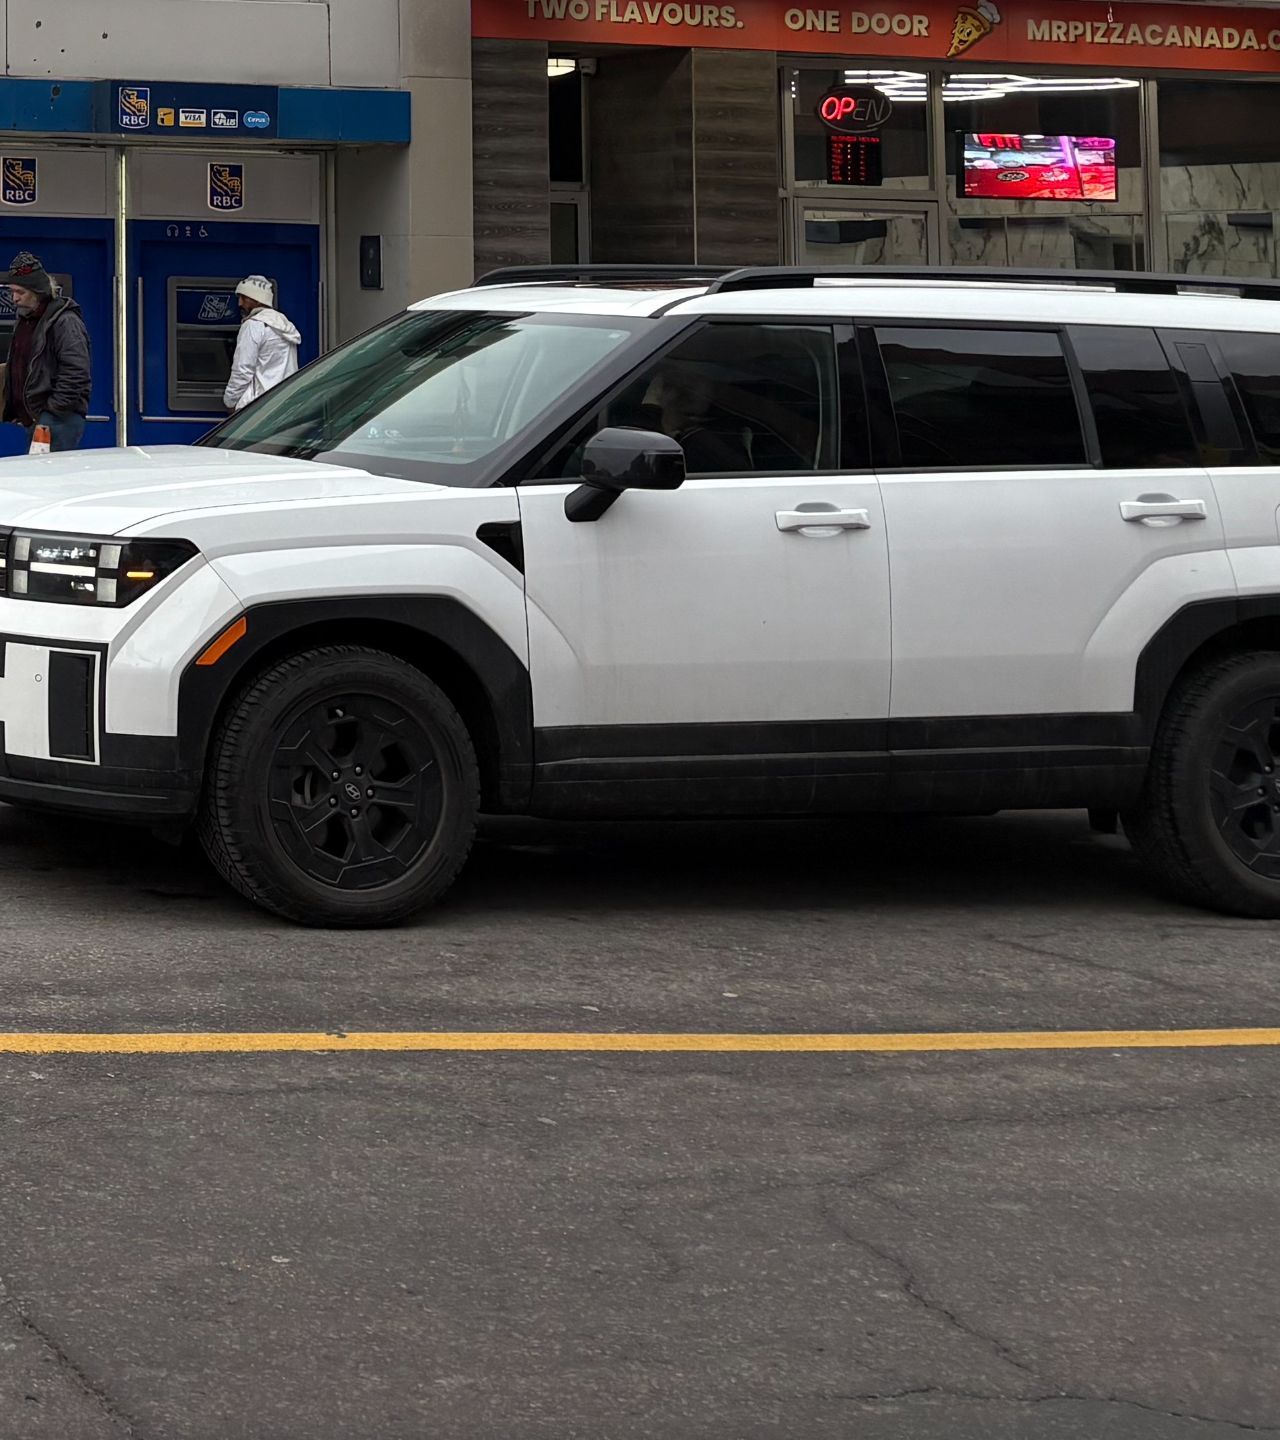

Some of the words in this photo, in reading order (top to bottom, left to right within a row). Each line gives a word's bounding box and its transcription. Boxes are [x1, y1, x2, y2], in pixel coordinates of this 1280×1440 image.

[595, 0, 744, 29] FLAVOURS.
[784, 8, 841, 33] ONE
[852, 12, 930, 37] DOOR
[821, 96, 886, 121] OPEN
[122, 114, 146, 125] RBC
[5, 189, 34, 202] RBC
[213, 195, 240, 208] RBC
